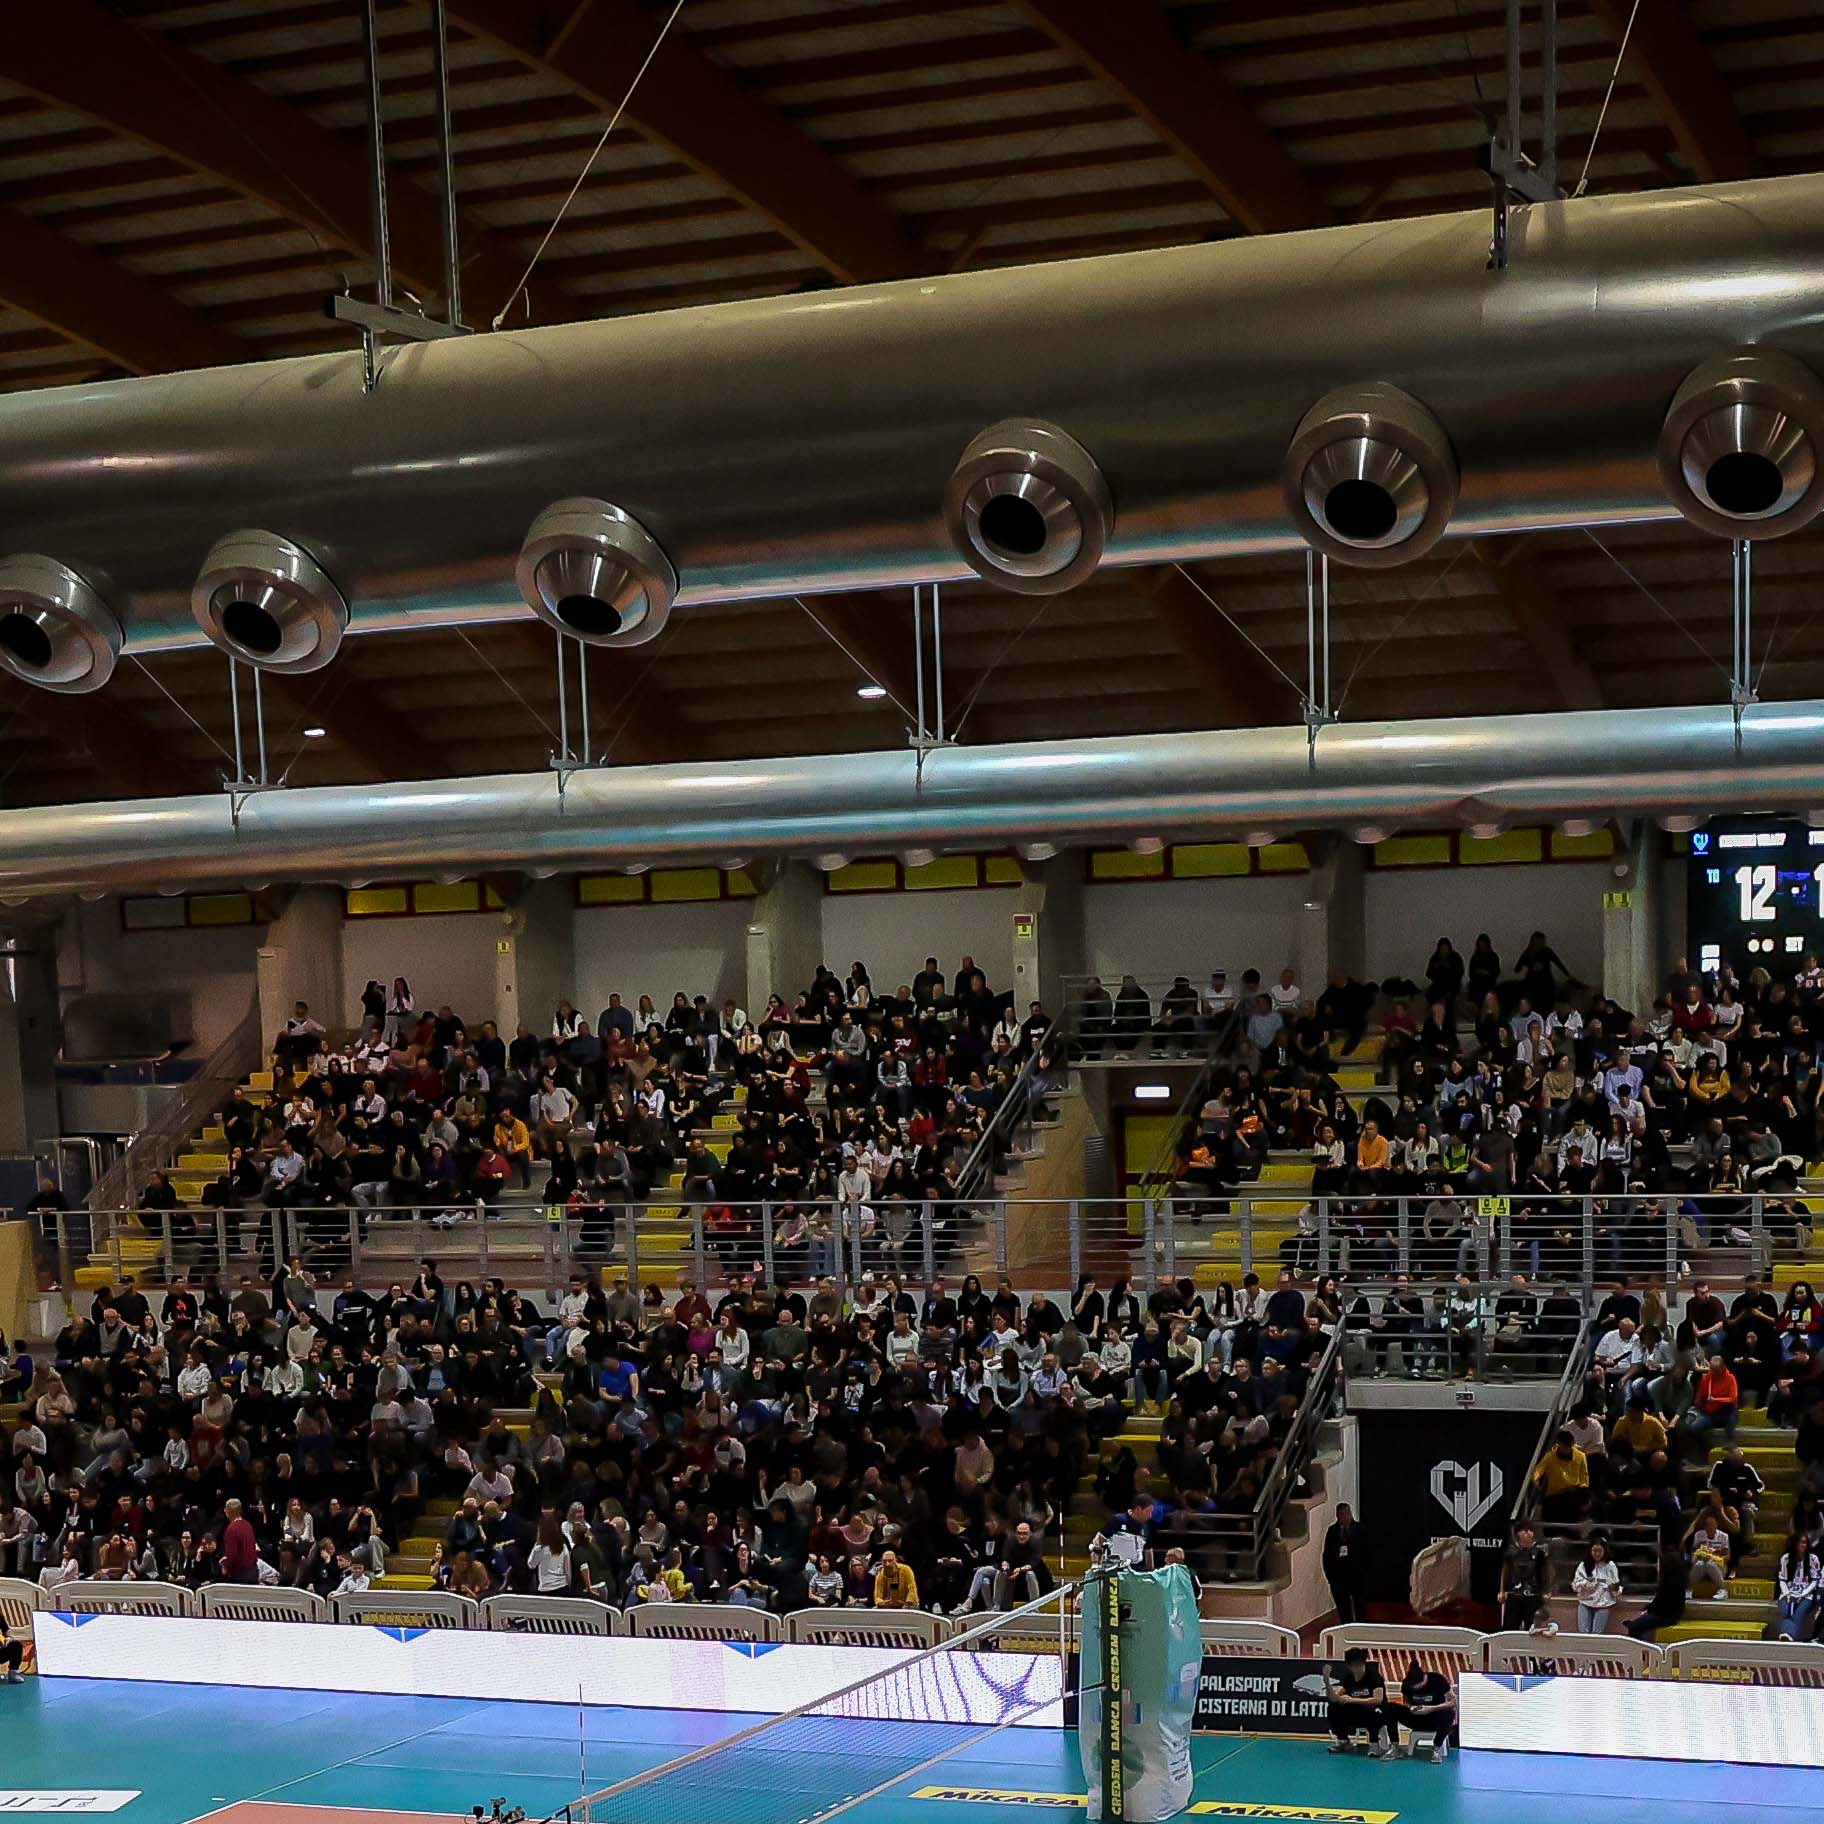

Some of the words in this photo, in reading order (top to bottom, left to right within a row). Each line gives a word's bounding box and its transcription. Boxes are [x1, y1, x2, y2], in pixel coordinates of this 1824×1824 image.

[1735, 865, 1776, 921] 12
[1108, 1577, 1118, 1627] BANCA
[1110, 1634, 1120, 1692] CREDEM
[1199, 1674, 1280, 1694] PALASPORT
[1111, 1701, 1120, 1751] BANCA
[1198, 1698, 1267, 1717] CISTERNA
[1272, 1701, 1285, 1717] DI
[1111, 1759, 1122, 1816] CREDEM
